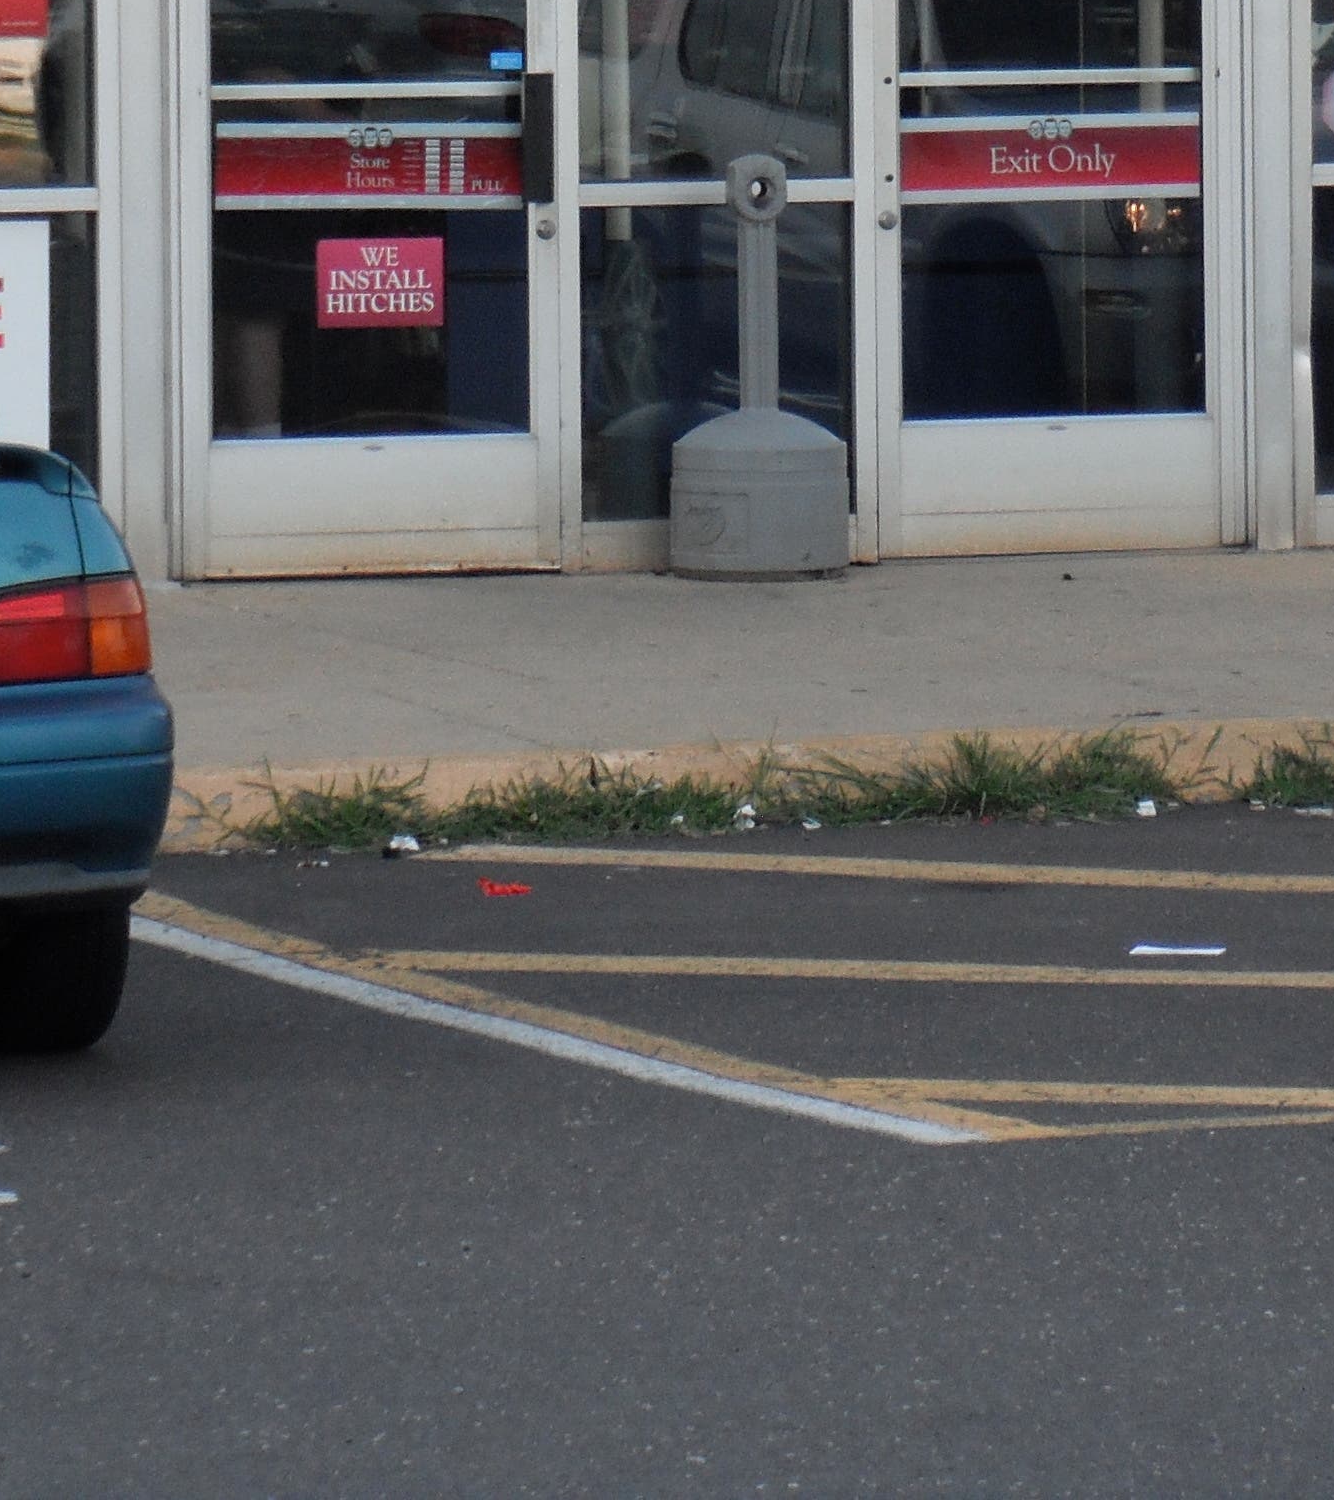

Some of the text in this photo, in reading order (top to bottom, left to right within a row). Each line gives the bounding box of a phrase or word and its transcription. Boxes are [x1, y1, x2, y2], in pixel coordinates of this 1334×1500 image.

[350, 152, 390, 169] Store
[990, 142, 1116, 178] Exit Only
[346, 171, 396, 188] Hours
[472, 179, 504, 192] PULL
[361, 246, 399, 267] WE
[330, 269, 432, 290] INSTALL
[326, 292, 436, 314] HITCHES
